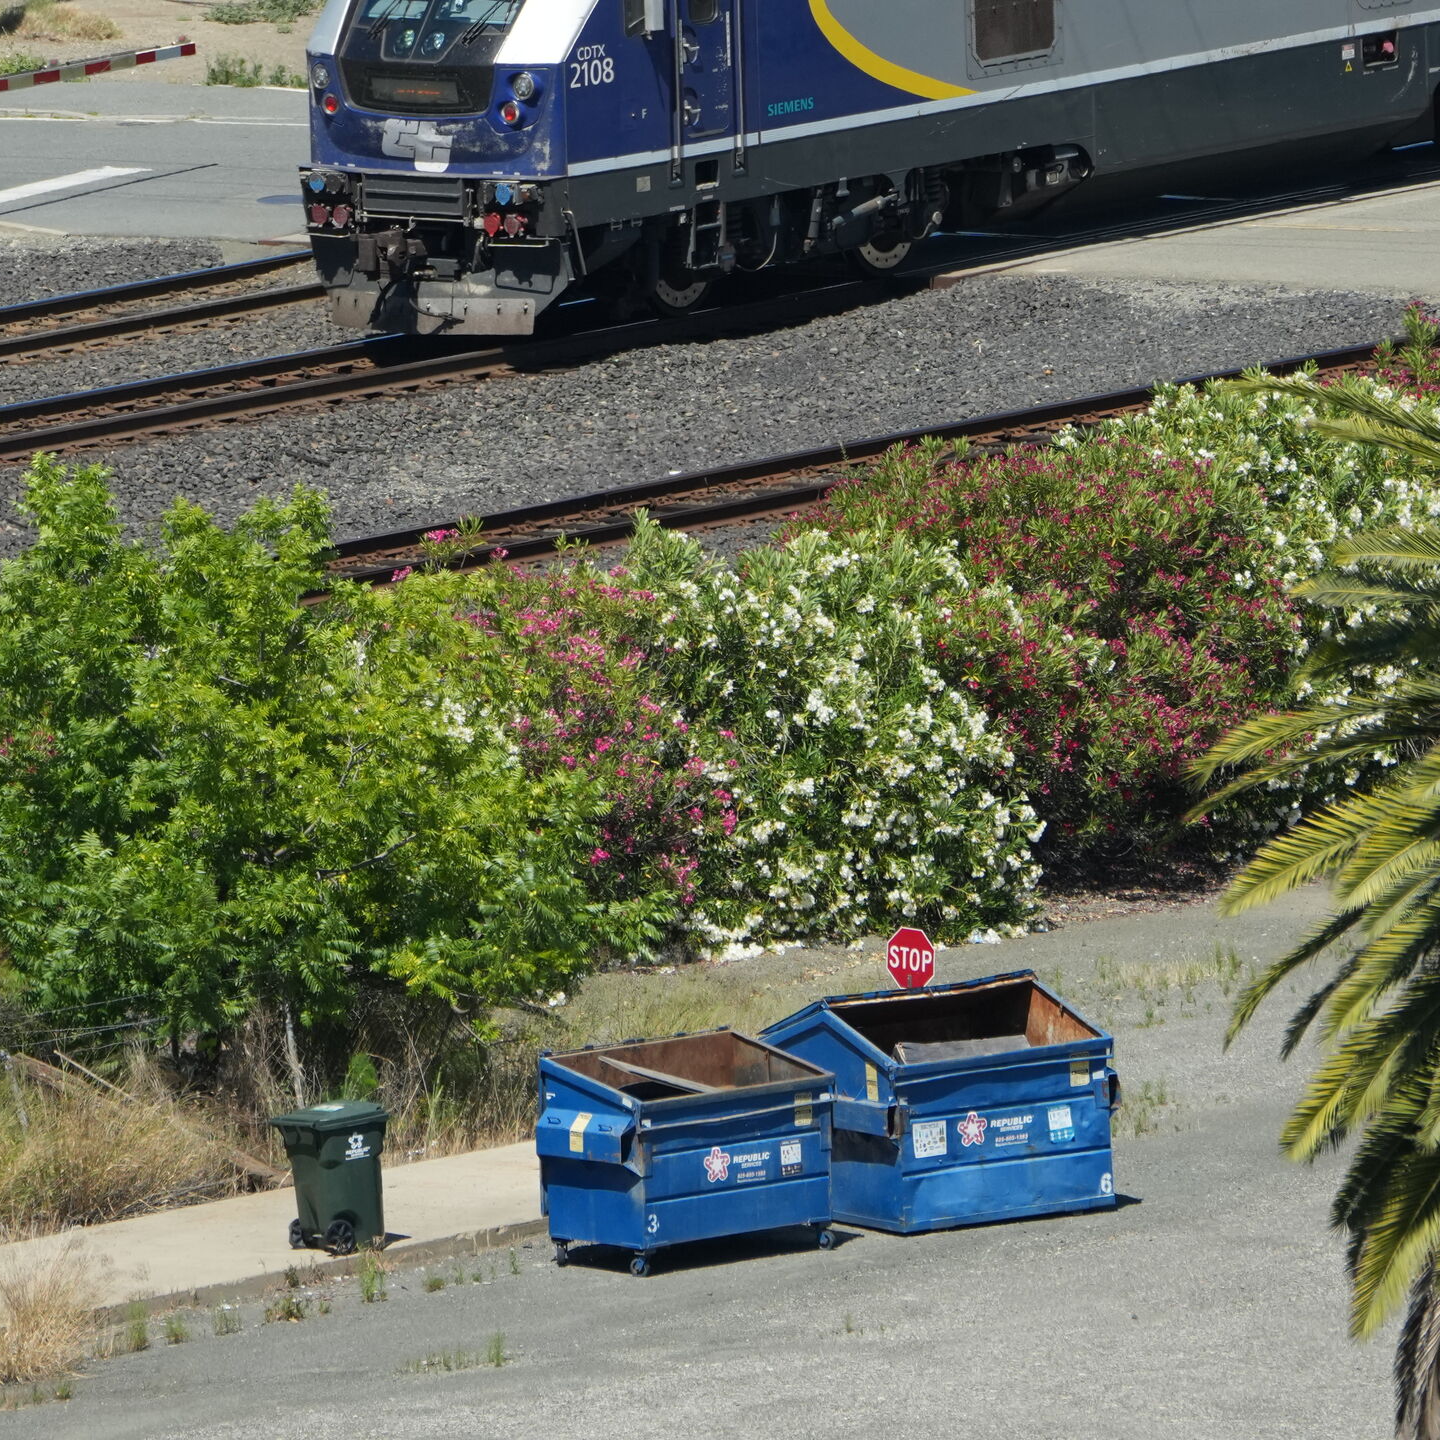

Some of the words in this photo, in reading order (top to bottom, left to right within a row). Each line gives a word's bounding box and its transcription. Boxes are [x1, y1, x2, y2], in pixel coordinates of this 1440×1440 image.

[577, 44, 606, 61] CDTX
[570, 57, 615, 89] 2108
[641, 108, 648, 119] F
[767, 96, 815, 117] SIEMENS
[889, 945, 933, 973] STOP
[990, 1115, 1033, 1128] REPUBLIC
[733, 1151, 770, 1164] REPUBLIC
[1100, 1172, 1112, 1194] 6
[647, 1214, 658, 1234] 3
